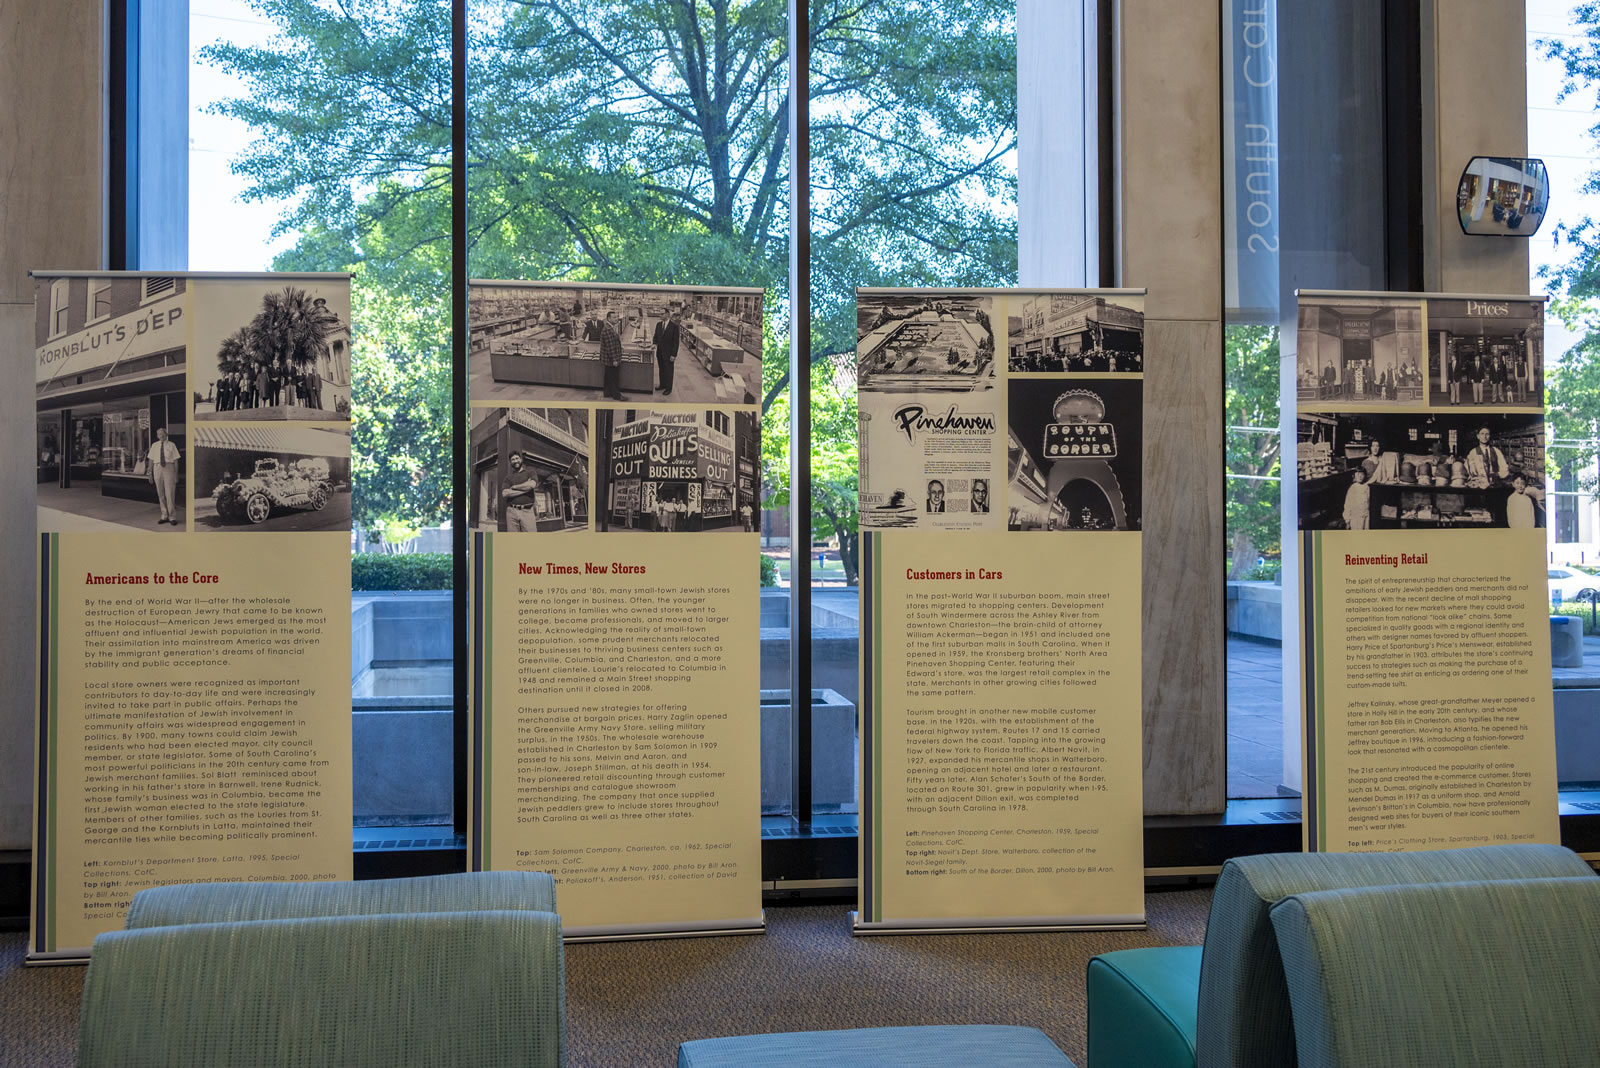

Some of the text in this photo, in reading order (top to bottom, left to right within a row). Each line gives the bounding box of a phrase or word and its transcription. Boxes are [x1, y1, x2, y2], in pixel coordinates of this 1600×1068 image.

[39, 323, 126, 366] KORNBLUT'S
[662, 412, 697, 424] AUCTION
[894, 406, 994, 442] Pinehaven
[620, 420, 649, 438] AUCTION
[1050, 426, 1110, 436] SOUTH
[612, 441, 648, 460] SELLING
[650, 434, 698, 464] QUITS
[698, 444, 732, 466] SELLING
[1050, 444, 1112, 455] BORDER
[615, 460, 644, 476] OUT
[650, 466, 698, 479] BUSINESS
[706, 464, 728, 480] OUT
[1344, 552, 1428, 568] Reinventing Retail
[518, 562, 646, 575] New Times, New Stores
[906, 567, 1002, 580] Customers in Cars
[85, 571, 219, 585] Americans to the Core
[84, 608, 135, 616] destruction
[149, 608, 191, 616] European
[930, 602, 966, 610] migrated
[978, 601, 1014, 610] shopping
[1051, 601, 1104, 610] Development
[108, 639, 159, 647] assimilation
[235, 637, 271, 645] America
[948, 659, 986, 668] Shopping
[1018, 659, 1055, 668] featuring
[518, 676, 536, 684] 1948
[654, 674, 691, 683] shopping
[936, 708, 967, 716] brought
[84, 733, 119, 742] politics.
[122, 732, 132, 741] By
[135, 731, 158, 740] 1900,
[215, 729, 241, 738] could
[270, 728, 297, 737] Jewish
[1347, 738, 1370, 746] Jeffrey
[1426, 735, 1465, 743] introducing
[1472, 733, 1524, 742] fashion-forward
[517, 745, 564, 754] established
[622, 743, 632, 751] by
[700, 741, 717, 749] 1909
